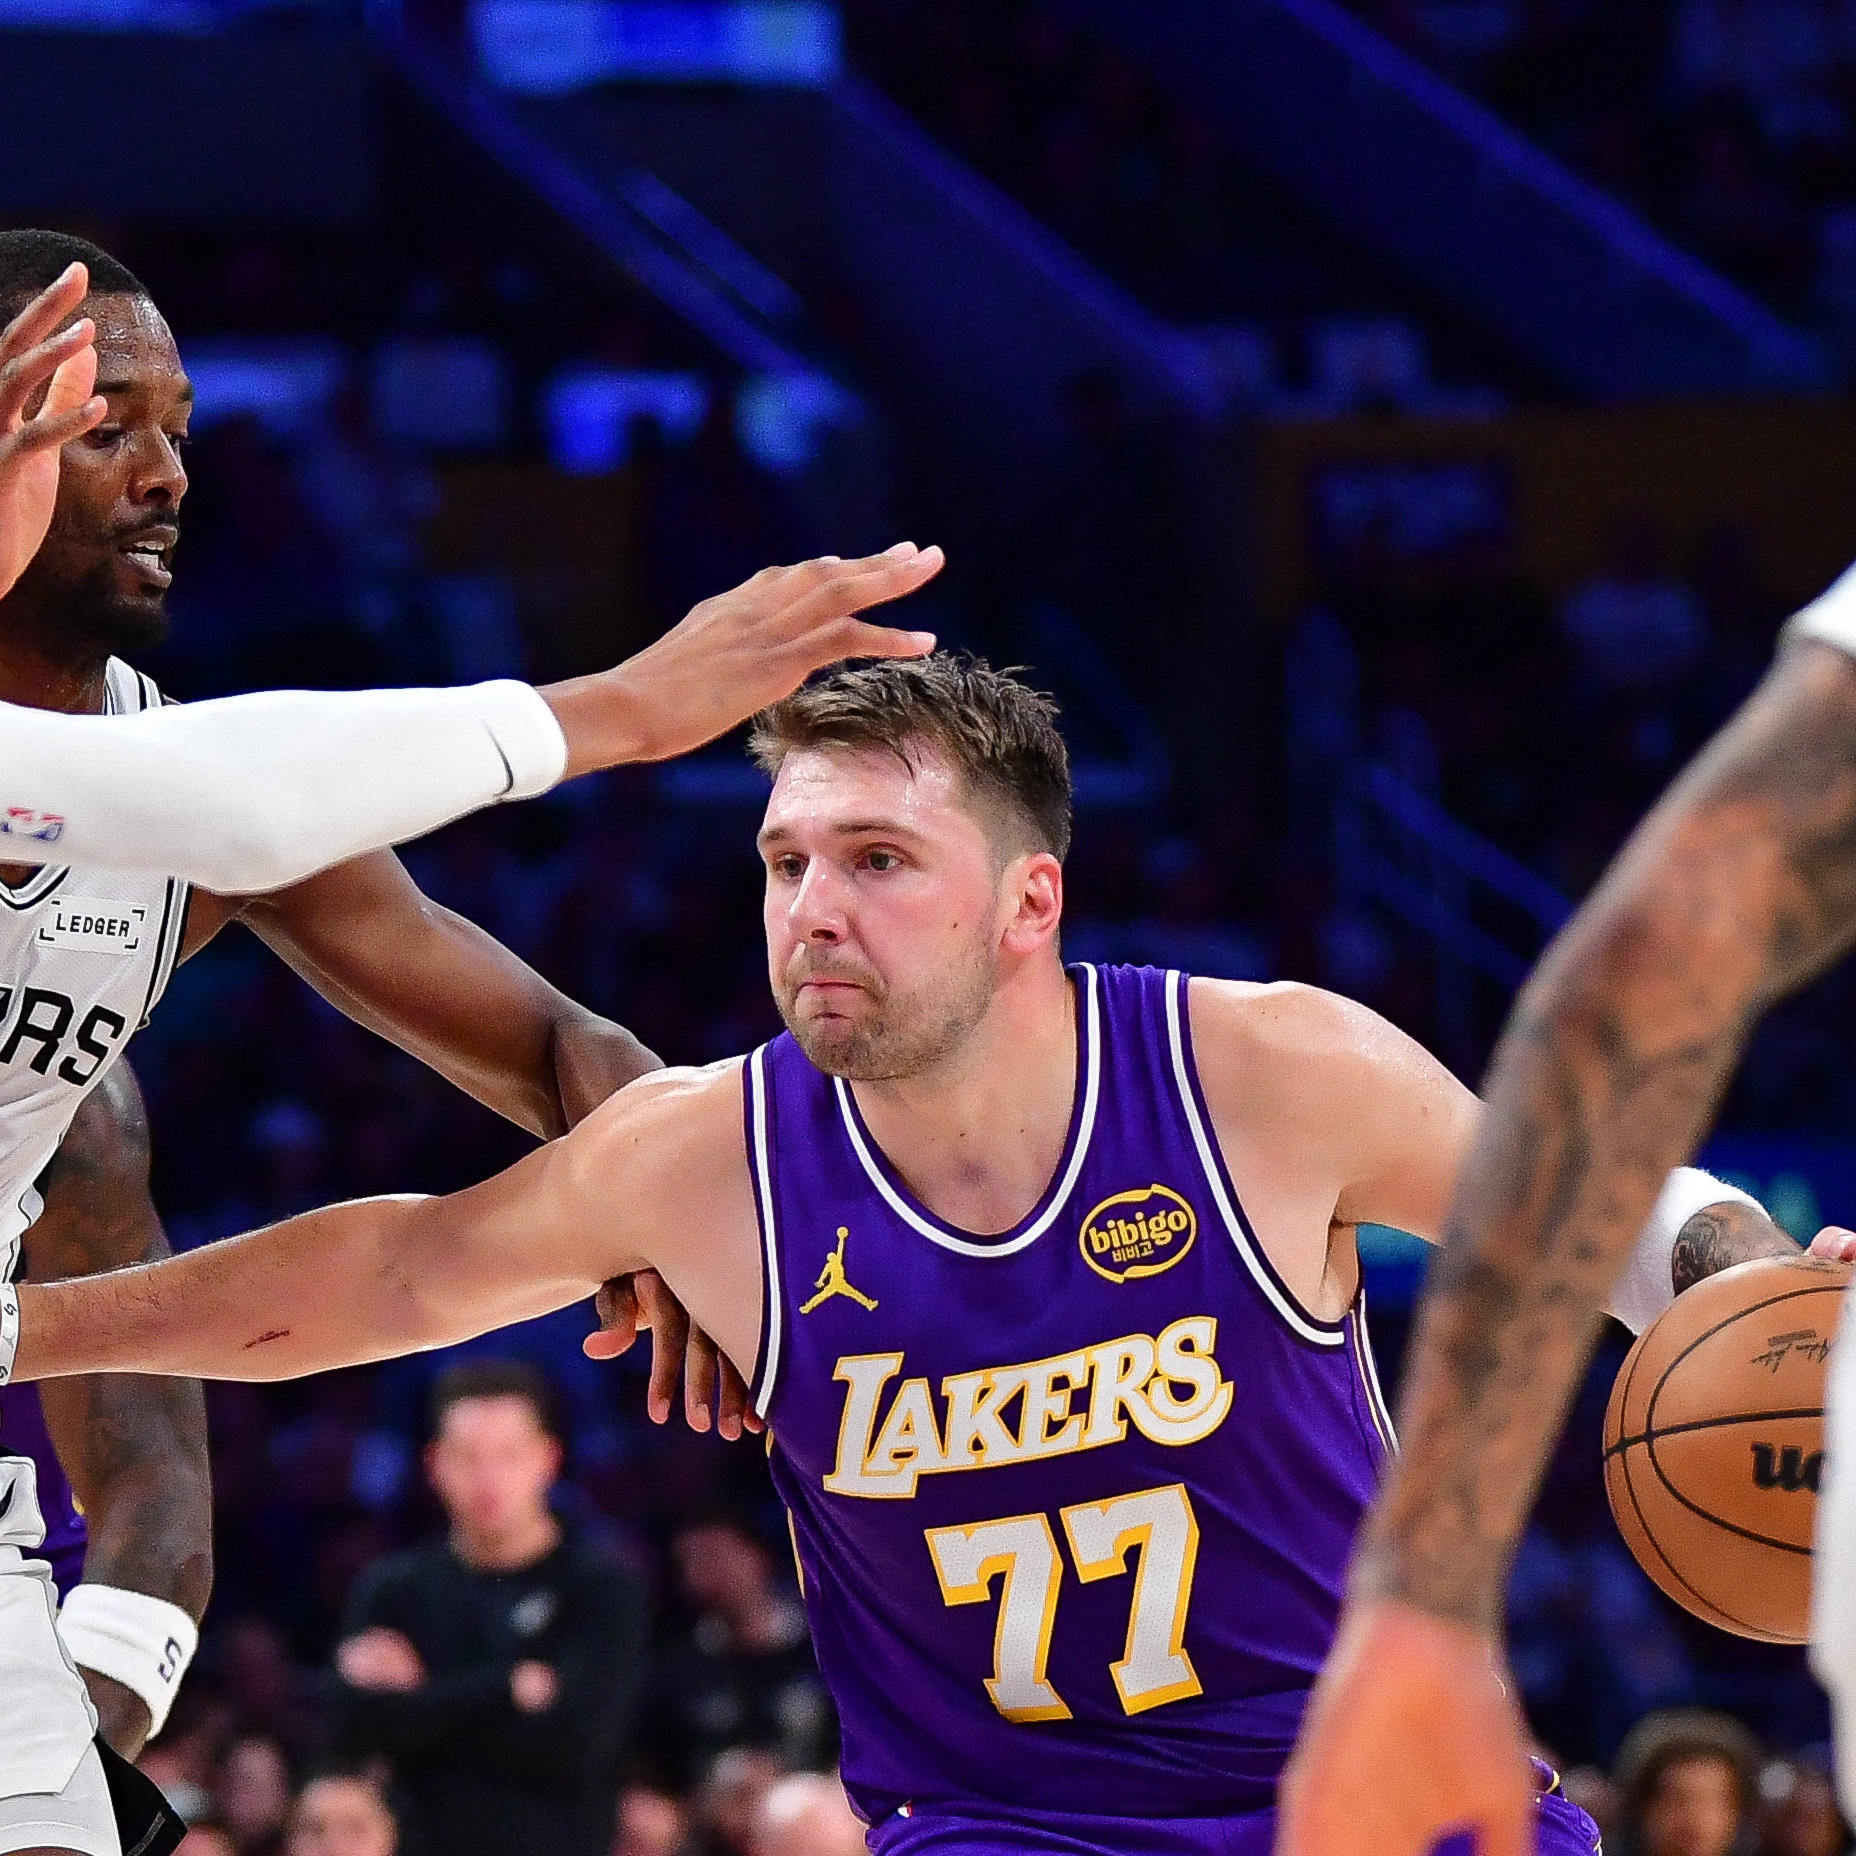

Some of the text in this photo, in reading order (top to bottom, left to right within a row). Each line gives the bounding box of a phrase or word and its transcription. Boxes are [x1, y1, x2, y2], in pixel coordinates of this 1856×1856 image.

[55, 912, 130, 938] LEDGER
[1088, 1209, 1188, 1254] bibigo
[1111, 1240, 1155, 1263] 비비고
[823, 1315, 1235, 1499] LAKERS
[924, 1484, 1204, 1723] 77
